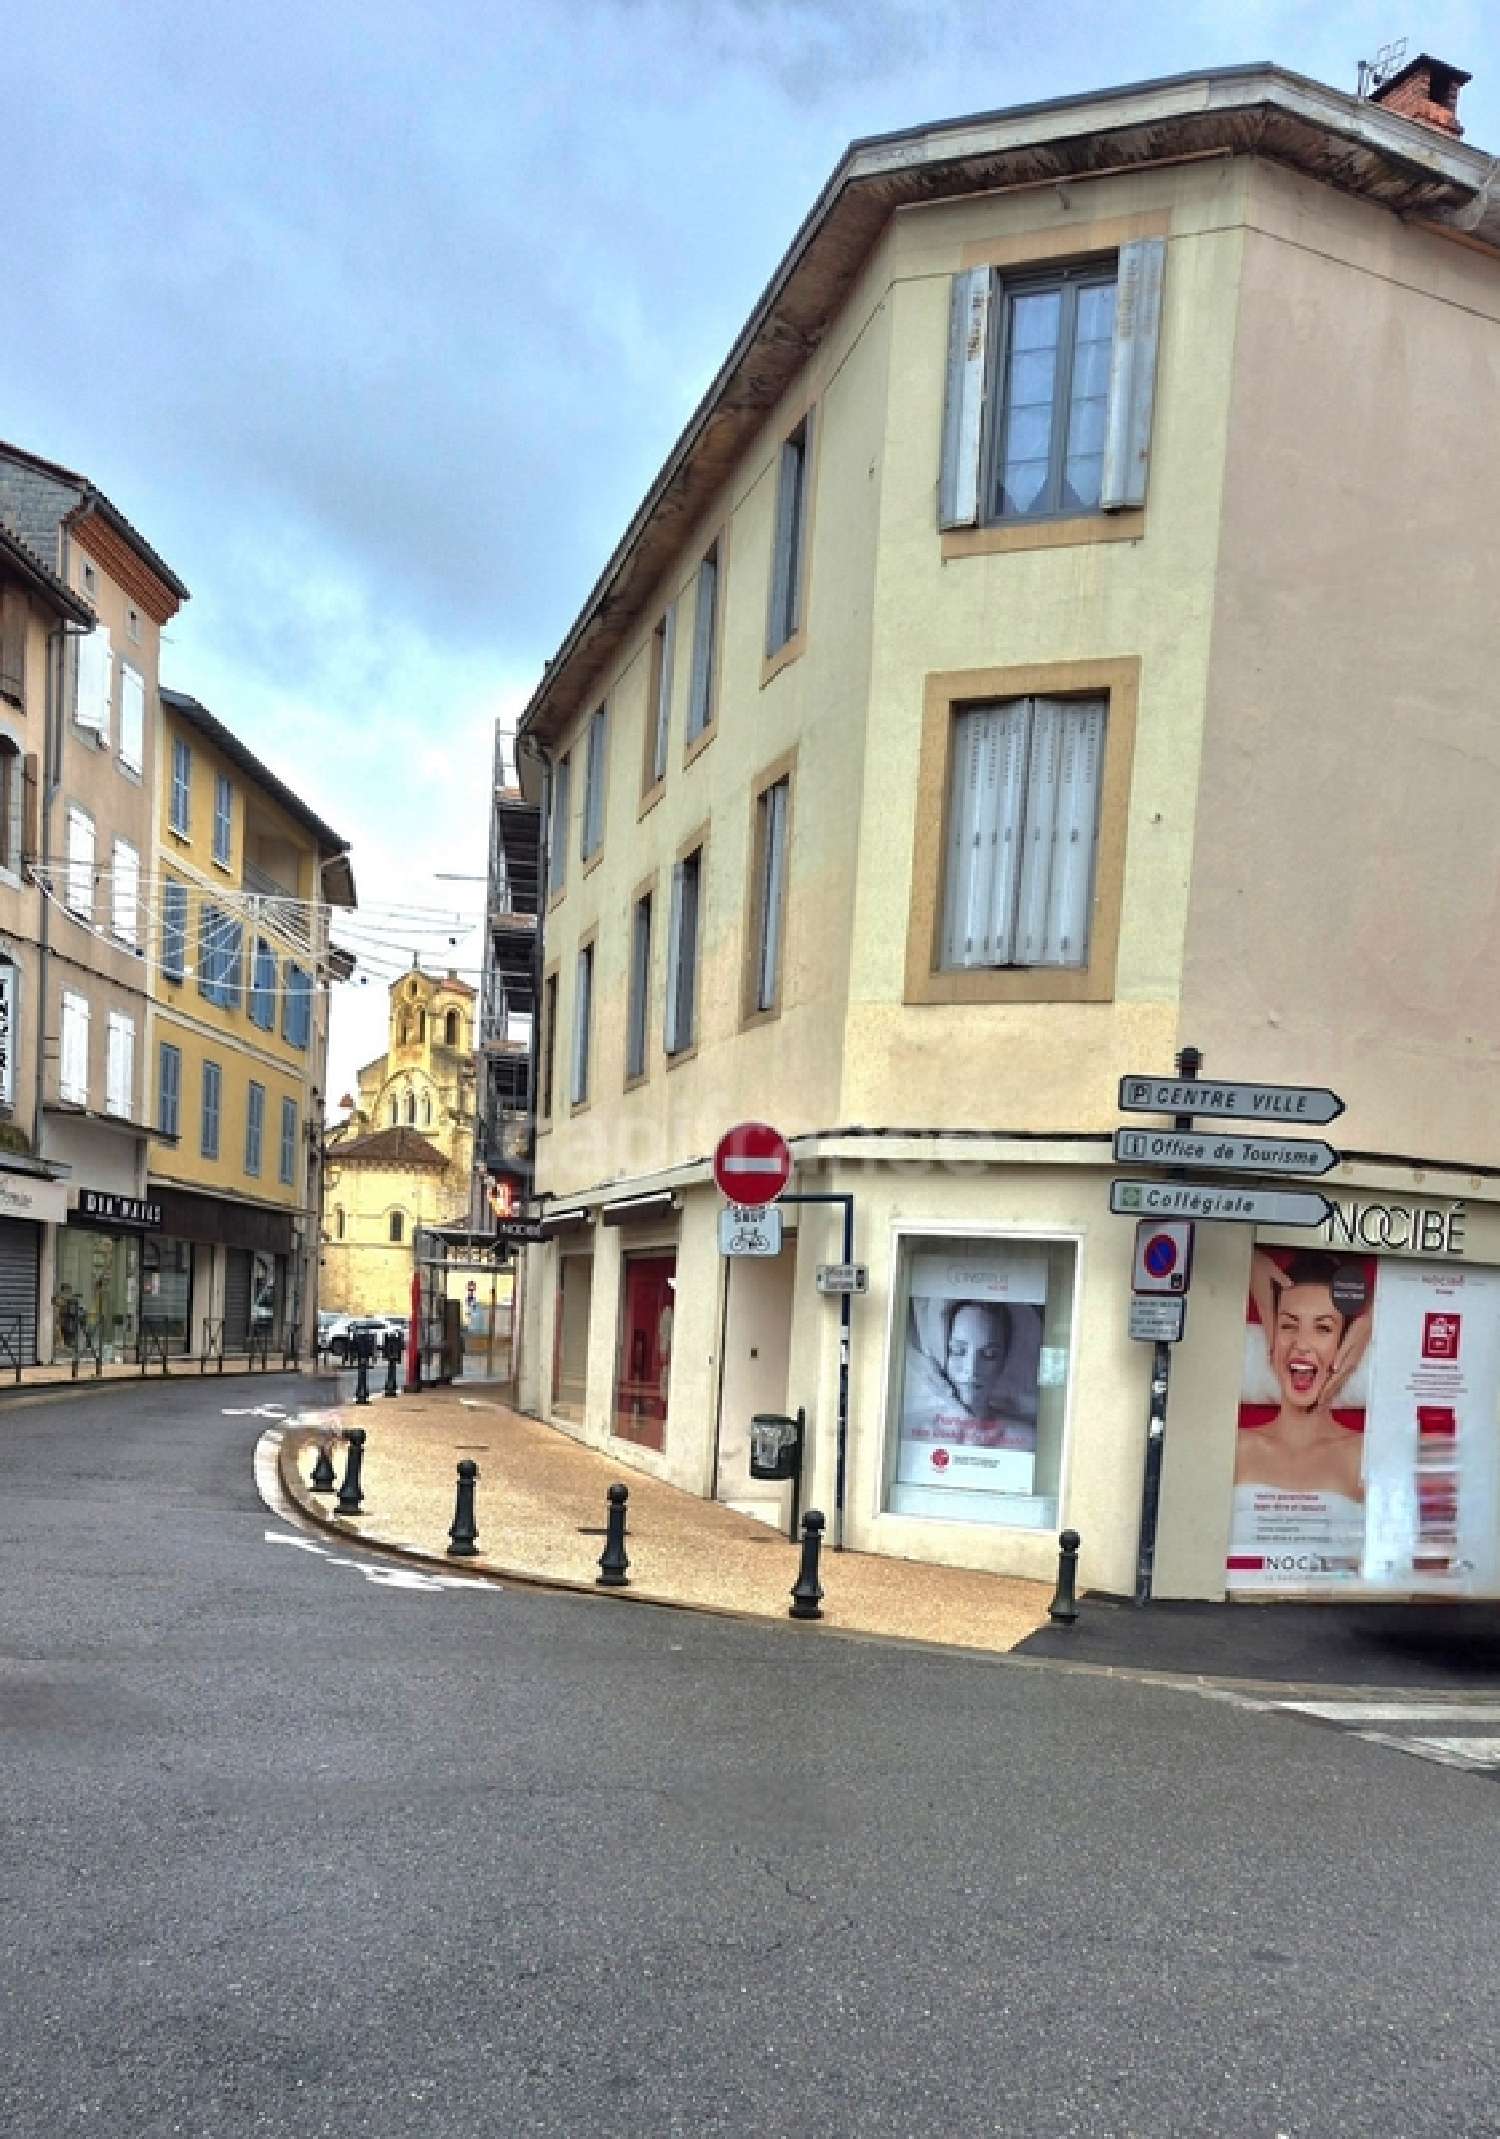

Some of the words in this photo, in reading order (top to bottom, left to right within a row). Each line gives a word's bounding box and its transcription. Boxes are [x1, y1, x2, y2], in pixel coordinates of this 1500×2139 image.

[1157, 1087, 1236, 1108] CENTRE
[1253, 1094, 1308, 1113] VILLE
[1151, 1138, 1204, 1159] Office
[1213, 1143, 1234, 1160] de
[1242, 1143, 1319, 1166] Tourisme
[1326, 1200, 1466, 1254] NOCIBÉ
